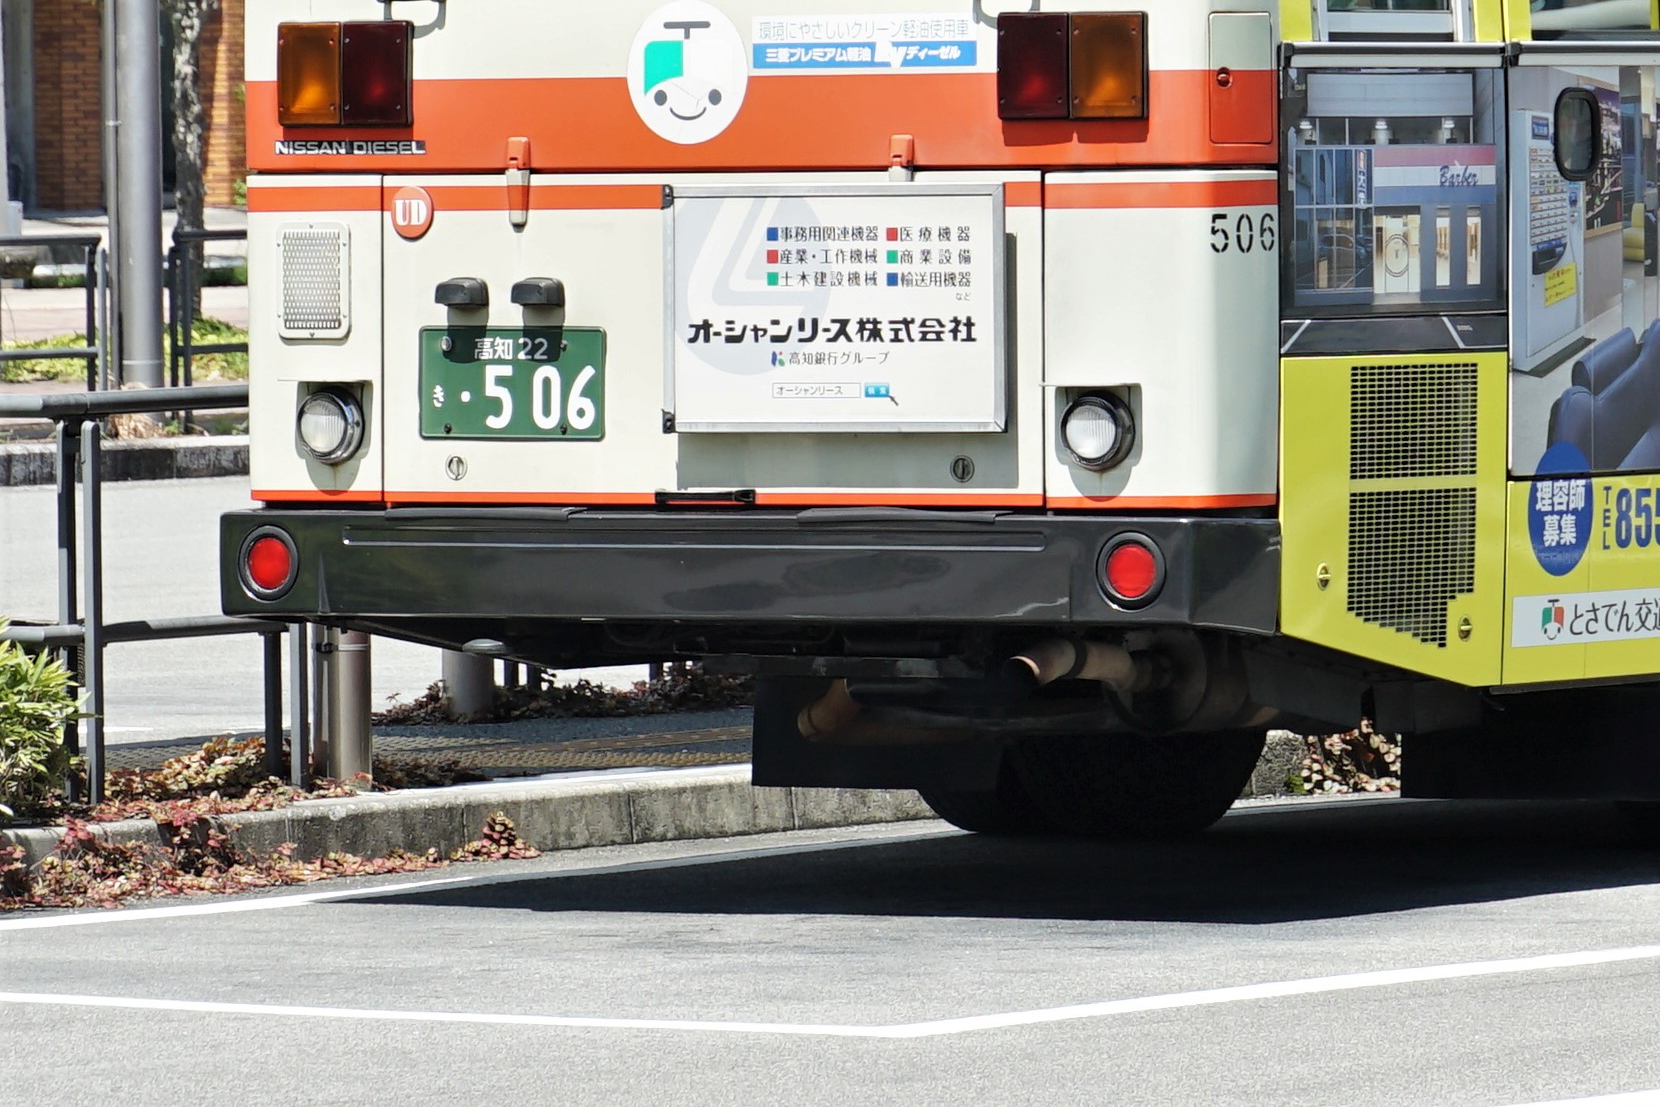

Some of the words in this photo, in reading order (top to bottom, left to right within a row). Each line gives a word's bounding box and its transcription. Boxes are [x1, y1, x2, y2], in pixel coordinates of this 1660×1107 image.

[275, 140, 346, 155] NISSAN
[353, 140, 426, 155] DIESEL
[394, 199, 428, 226] UD
[780, 226, 879, 242] 事務用関連機器
[900, 226, 970, 242] 医療機器
[1210, 213, 1276, 254] 506
[780, 249, 878, 265] 産業・工作機械
[900, 249, 972, 265] 商業設備
[780, 271, 878, 287] 土木建設機械
[900, 271, 971, 287] 輸送用機器
[687, 316, 978, 343] オーシャンリース株式会社
[473, 338, 514, 360] 高知
[517, 338, 549, 360] 22
[788, 351, 890, 366] 高知銀行グループ
[432, 385, 446, 408] き
[776, 385, 844, 396] オーシャンリース
[1535, 478, 1586, 512] 理容師
[1602, 486, 1613, 550] TEL
[1543, 513, 1577, 547] 募集
